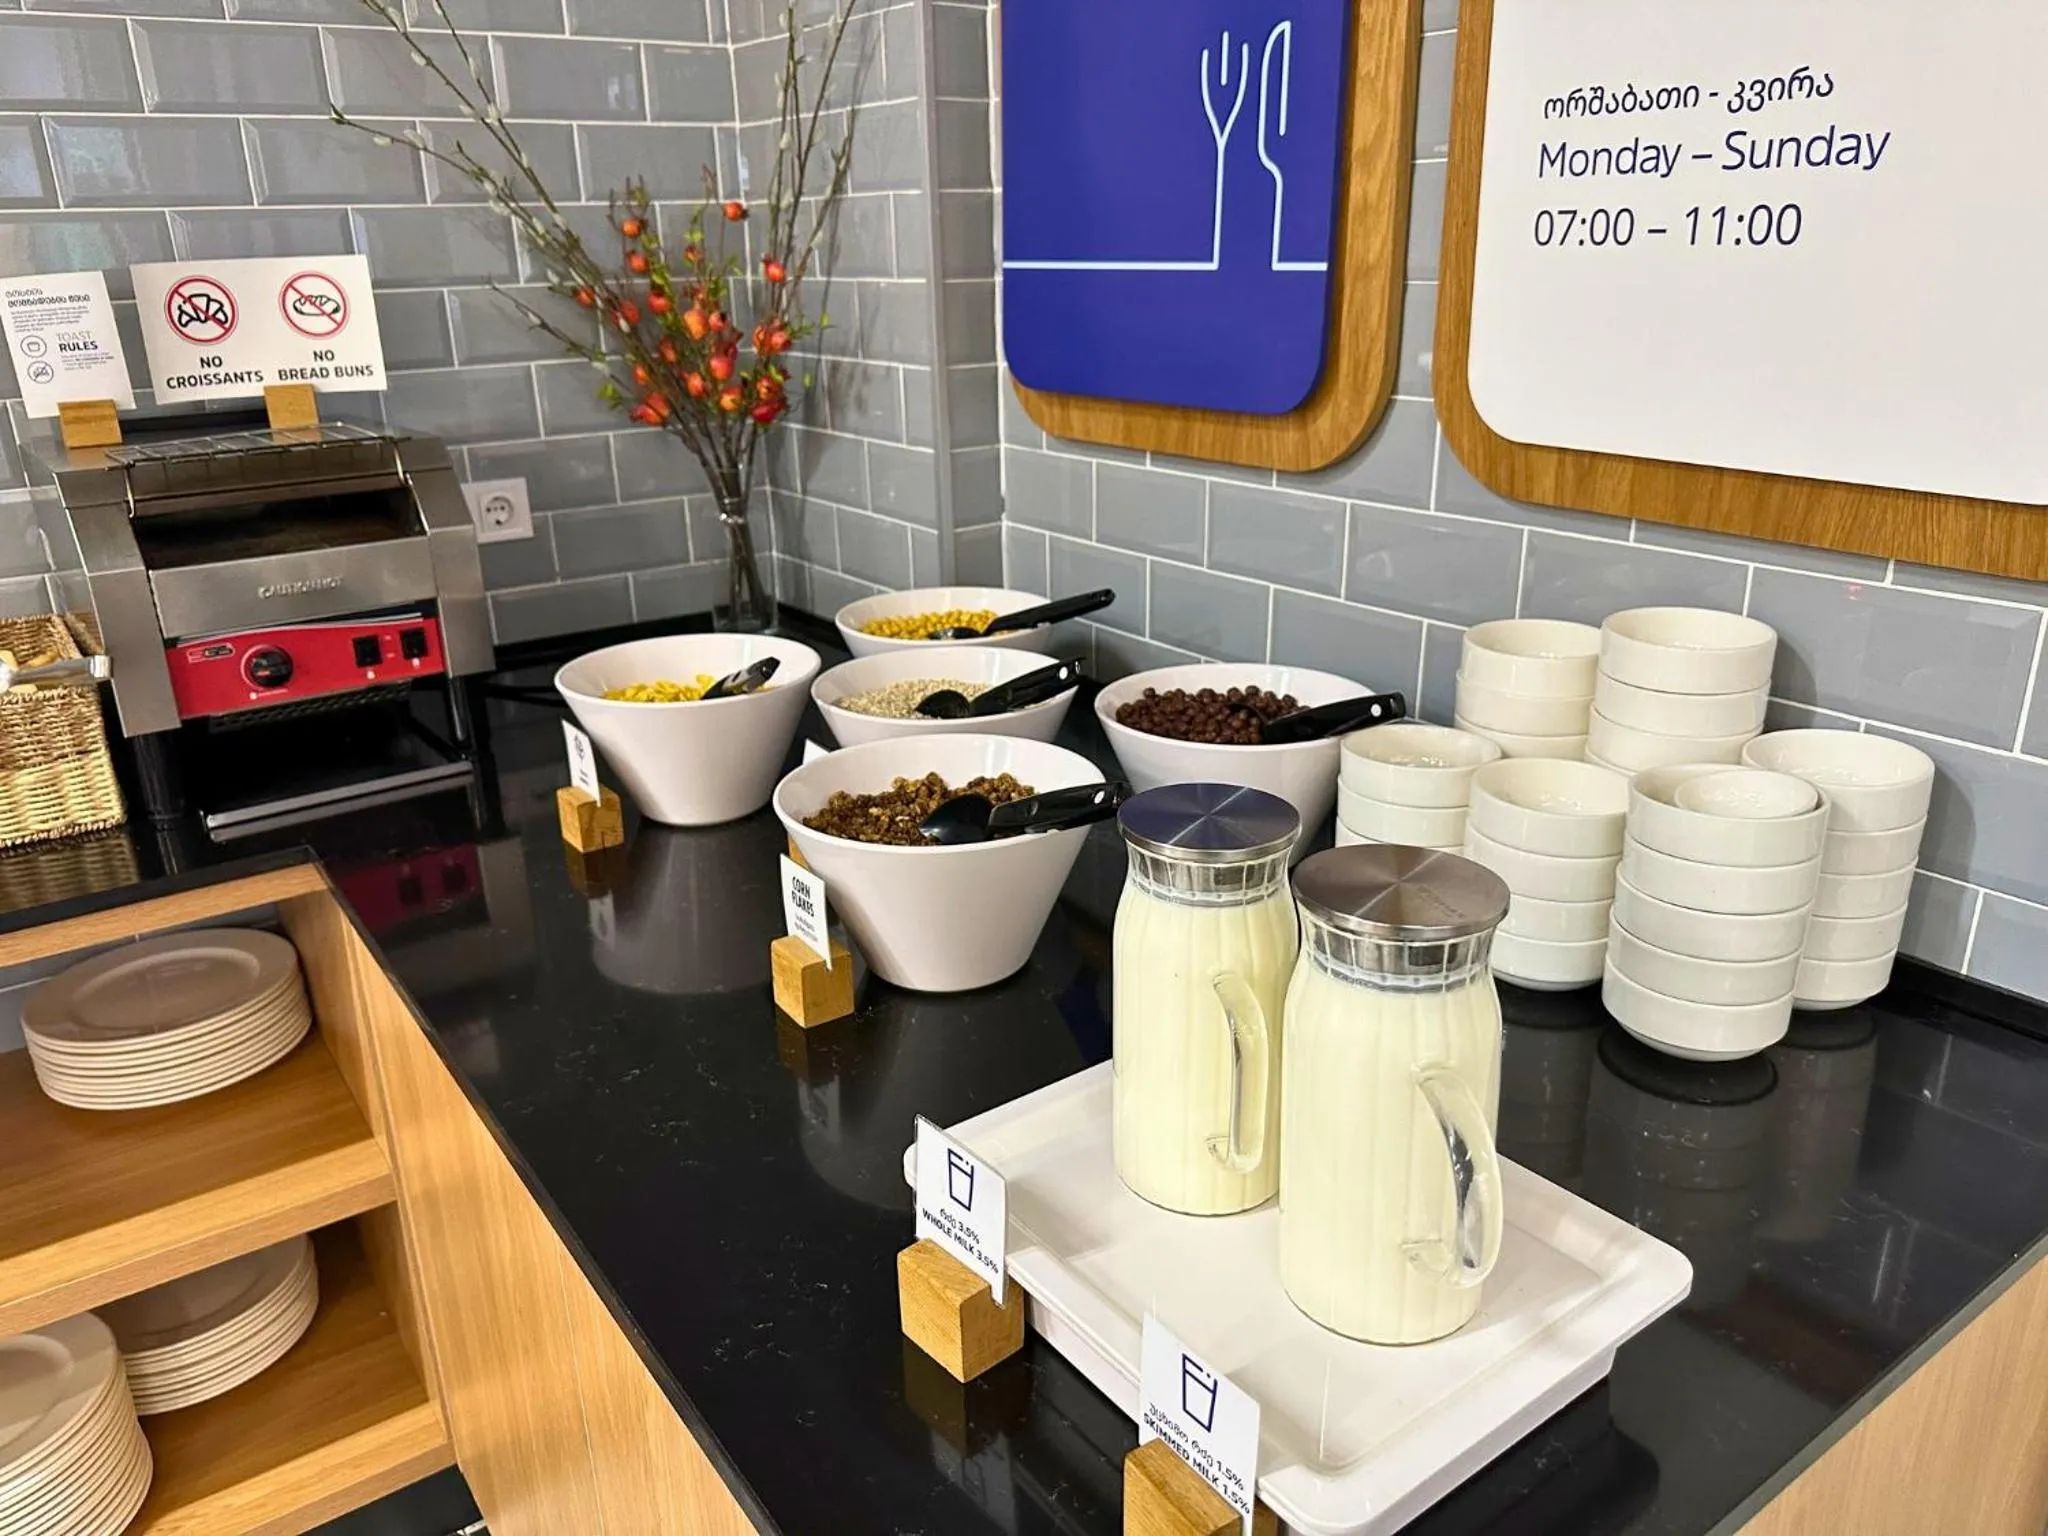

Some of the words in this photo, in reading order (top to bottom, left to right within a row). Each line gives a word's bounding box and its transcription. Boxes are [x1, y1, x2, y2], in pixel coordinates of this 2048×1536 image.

[1543, 84, 1700, 119] ორშაბათი
[1727, 65, 1834, 113] კვირა
[1539, 137, 1682, 178] Monday
[1721, 125, 1891, 171] Sunday
[1534, 207, 1635, 246] 07:00
[1685, 203, 1802, 246] 11:00
[56, 331, 92, 342] TOAST
[59, 341, 98, 352] RULES
[200, 355, 223, 369] NO
[313, 349, 335, 362] NO
[166, 370, 264, 390] CROISSANTS
[278, 368, 330, 381] BREAD
[335, 365, 374, 378] BUNS
[791, 876, 811, 899] CORN
[791, 890, 815, 918] FLAKES
[922, 1207, 952, 1238] WHOLE
[953, 1233, 975, 1256] MILK
[976, 1249, 999, 1274] 3.5%
[958, 1221, 980, 1245] 3.5%
[1143, 1412, 1190, 1461] SKIMMED
[1192, 1457, 1220, 1488] MILK
[1222, 1484, 1251, 1515] 1.5%
[1216, 1460, 1245, 1492] 1.5%
